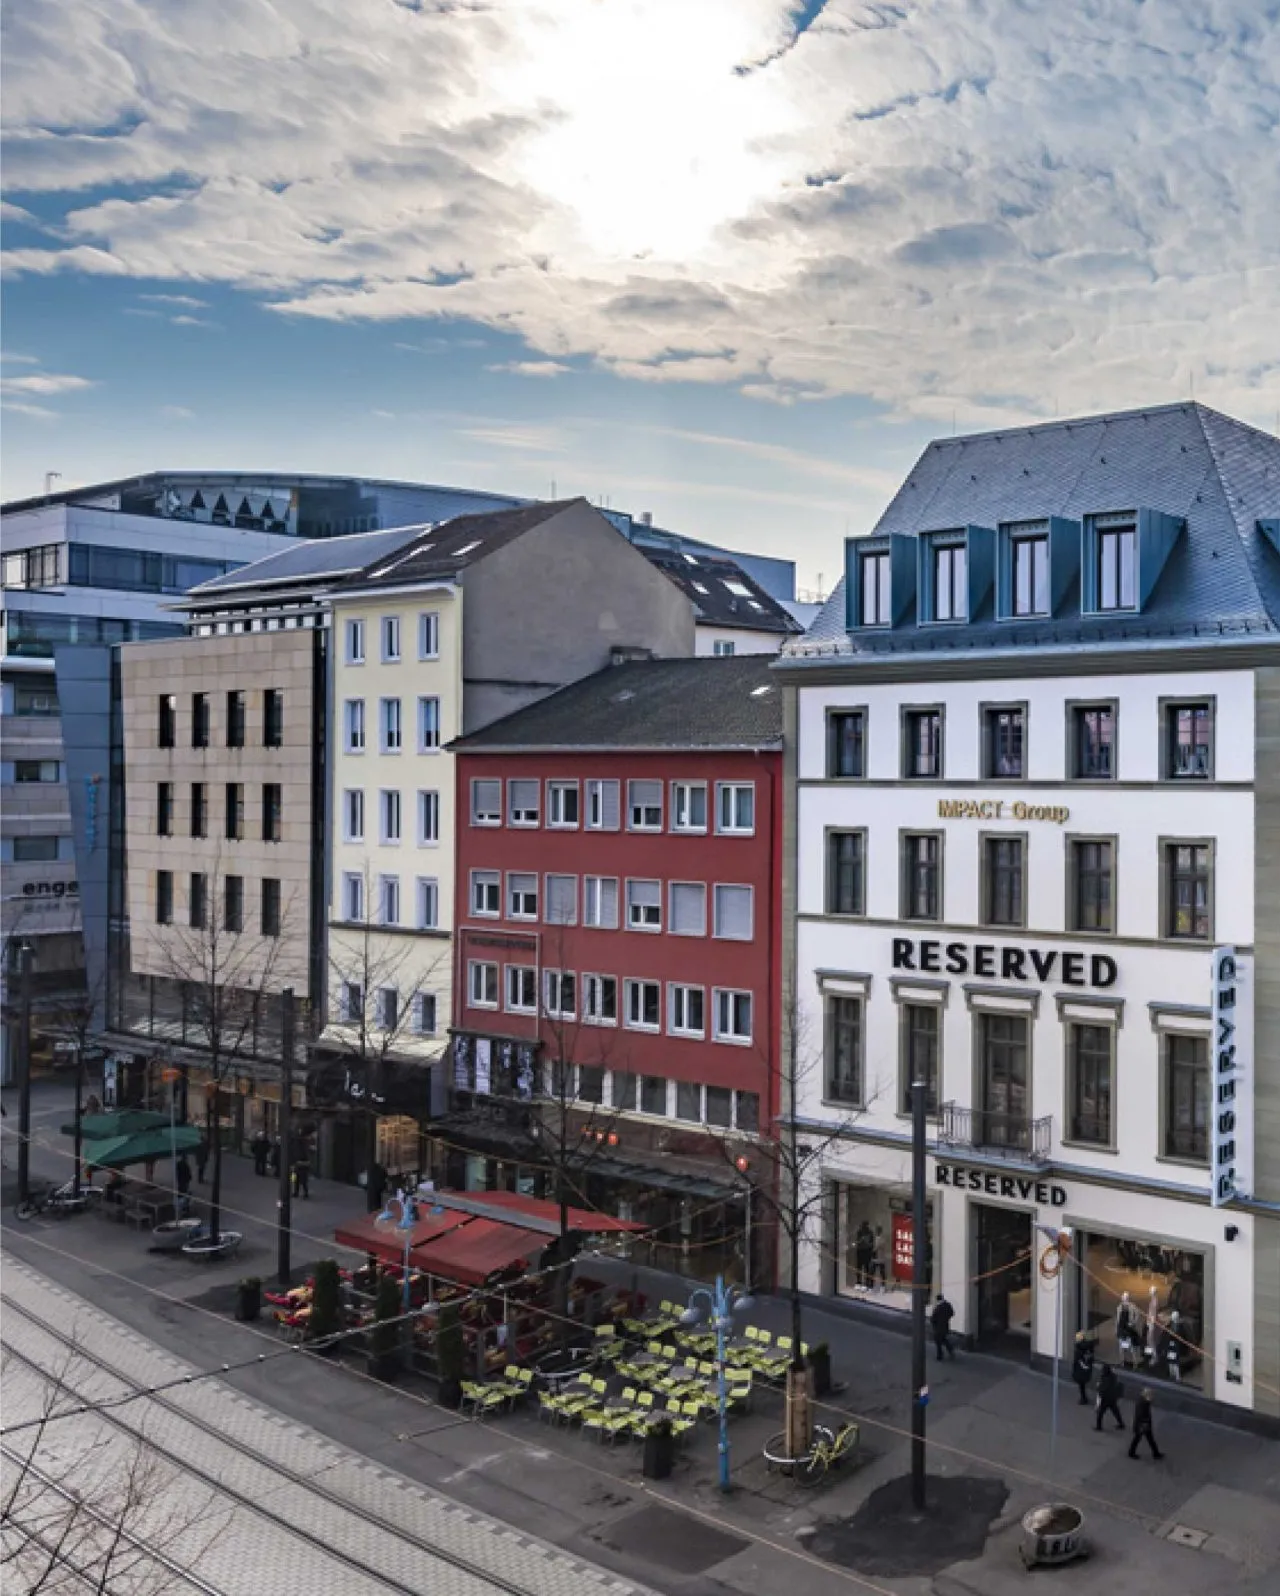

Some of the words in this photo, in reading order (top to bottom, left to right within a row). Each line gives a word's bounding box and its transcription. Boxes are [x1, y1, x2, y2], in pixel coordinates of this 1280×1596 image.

[938, 800, 1003, 819] IMPACT
[1012, 801, 1070, 824] Group
[892, 938, 1118, 987] RESERVED
[1219, 956, 1236, 1198] RESERVED
[936, 1165, 1067, 1206] RESERVED
